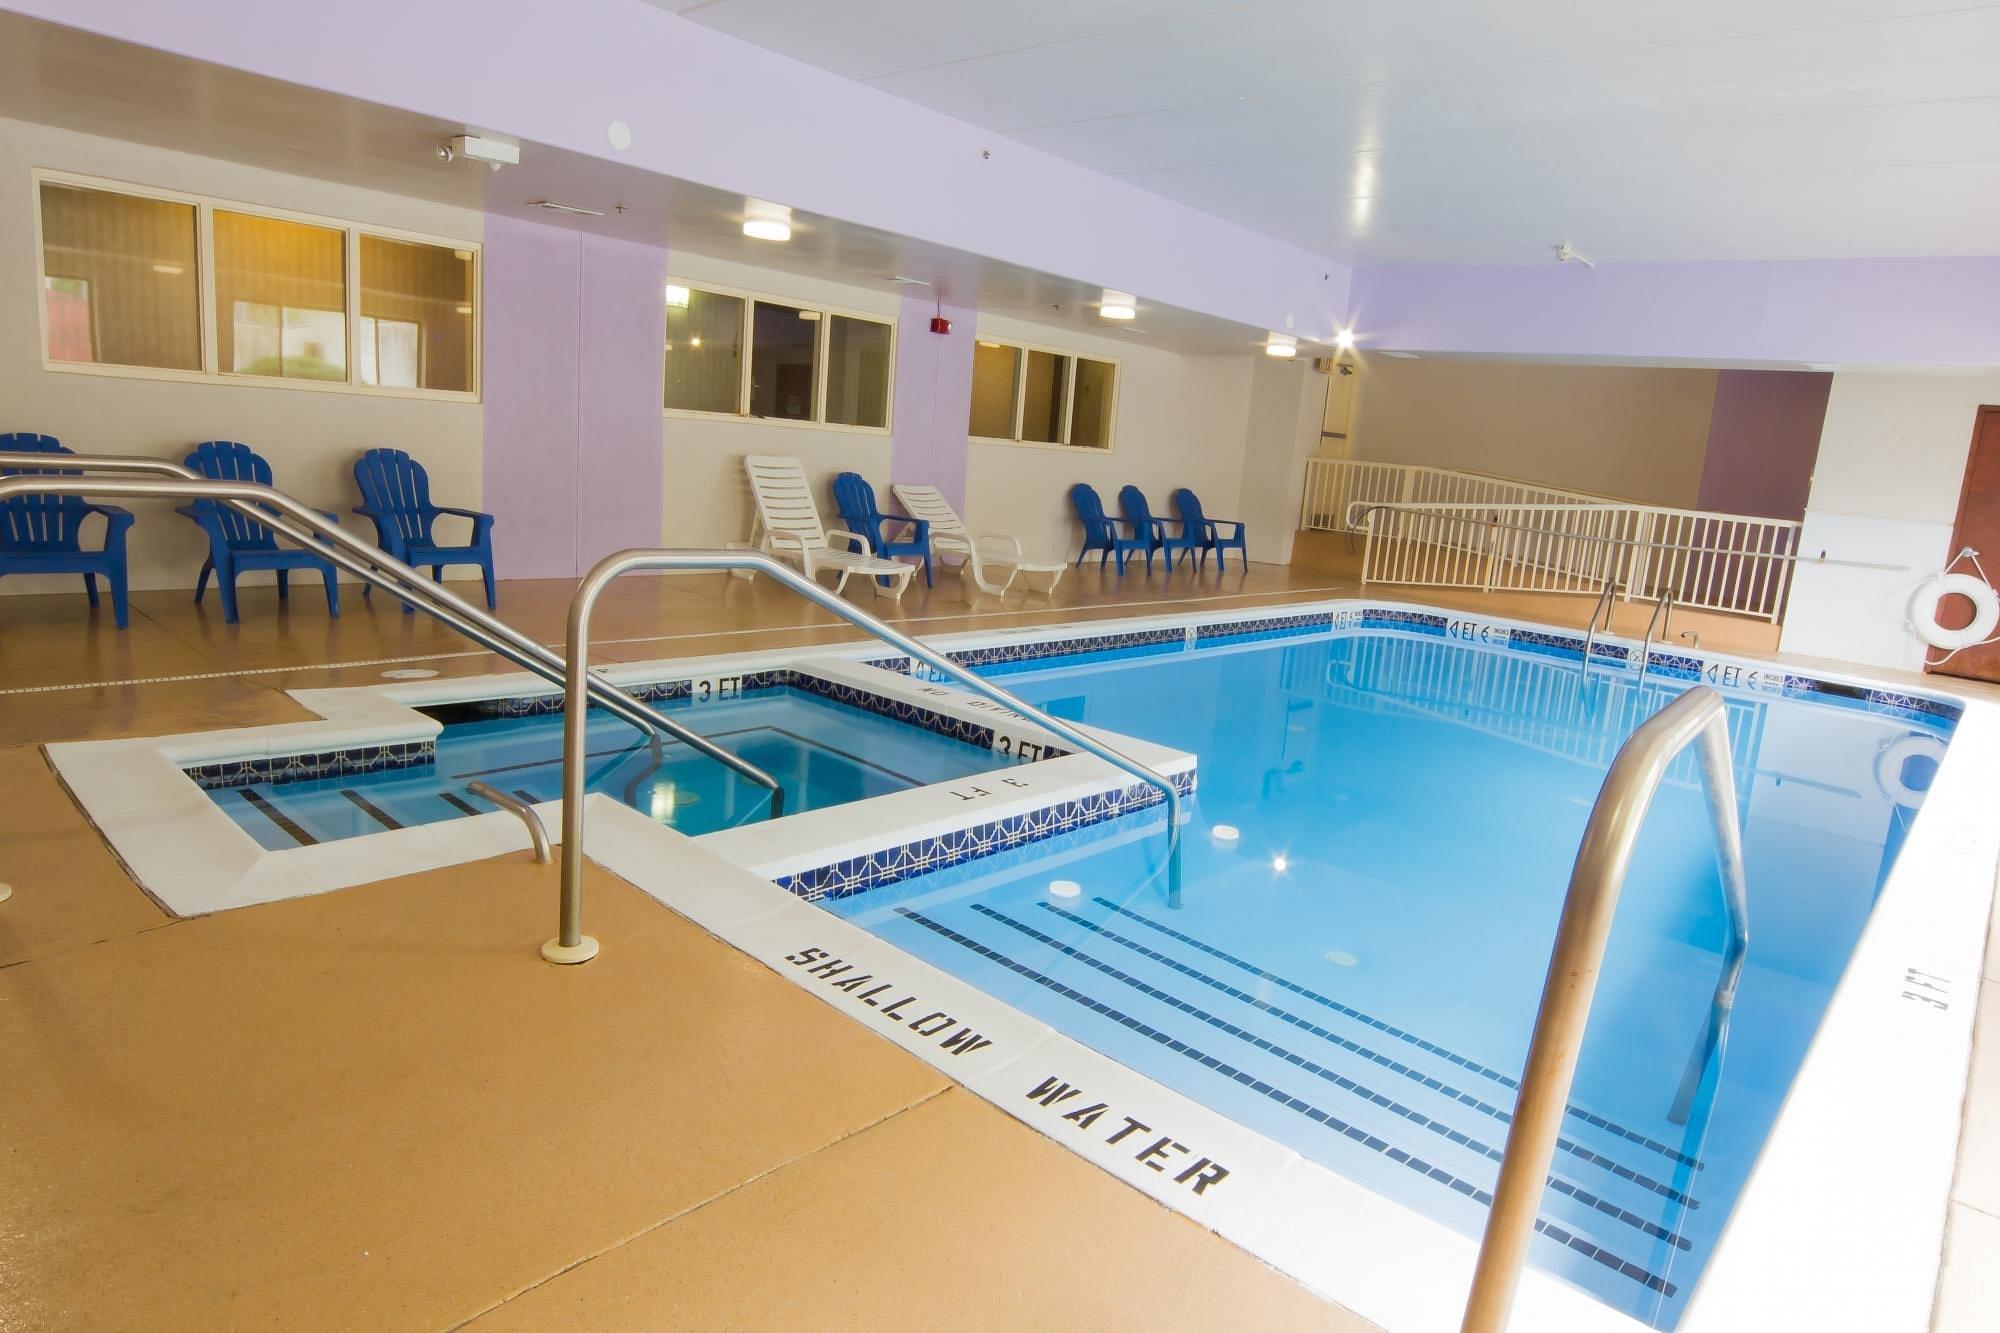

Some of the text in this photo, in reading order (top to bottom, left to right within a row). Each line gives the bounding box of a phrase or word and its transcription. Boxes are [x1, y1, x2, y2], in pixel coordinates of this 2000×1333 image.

[699, 677, 741, 702] 3 FT
[1763, 672, 1784, 682] INCHES
[999, 735, 1042, 762] 3 FT
[950, 786, 992, 801] FT
[783, 947, 1230, 1196] SHALLOW WATER
